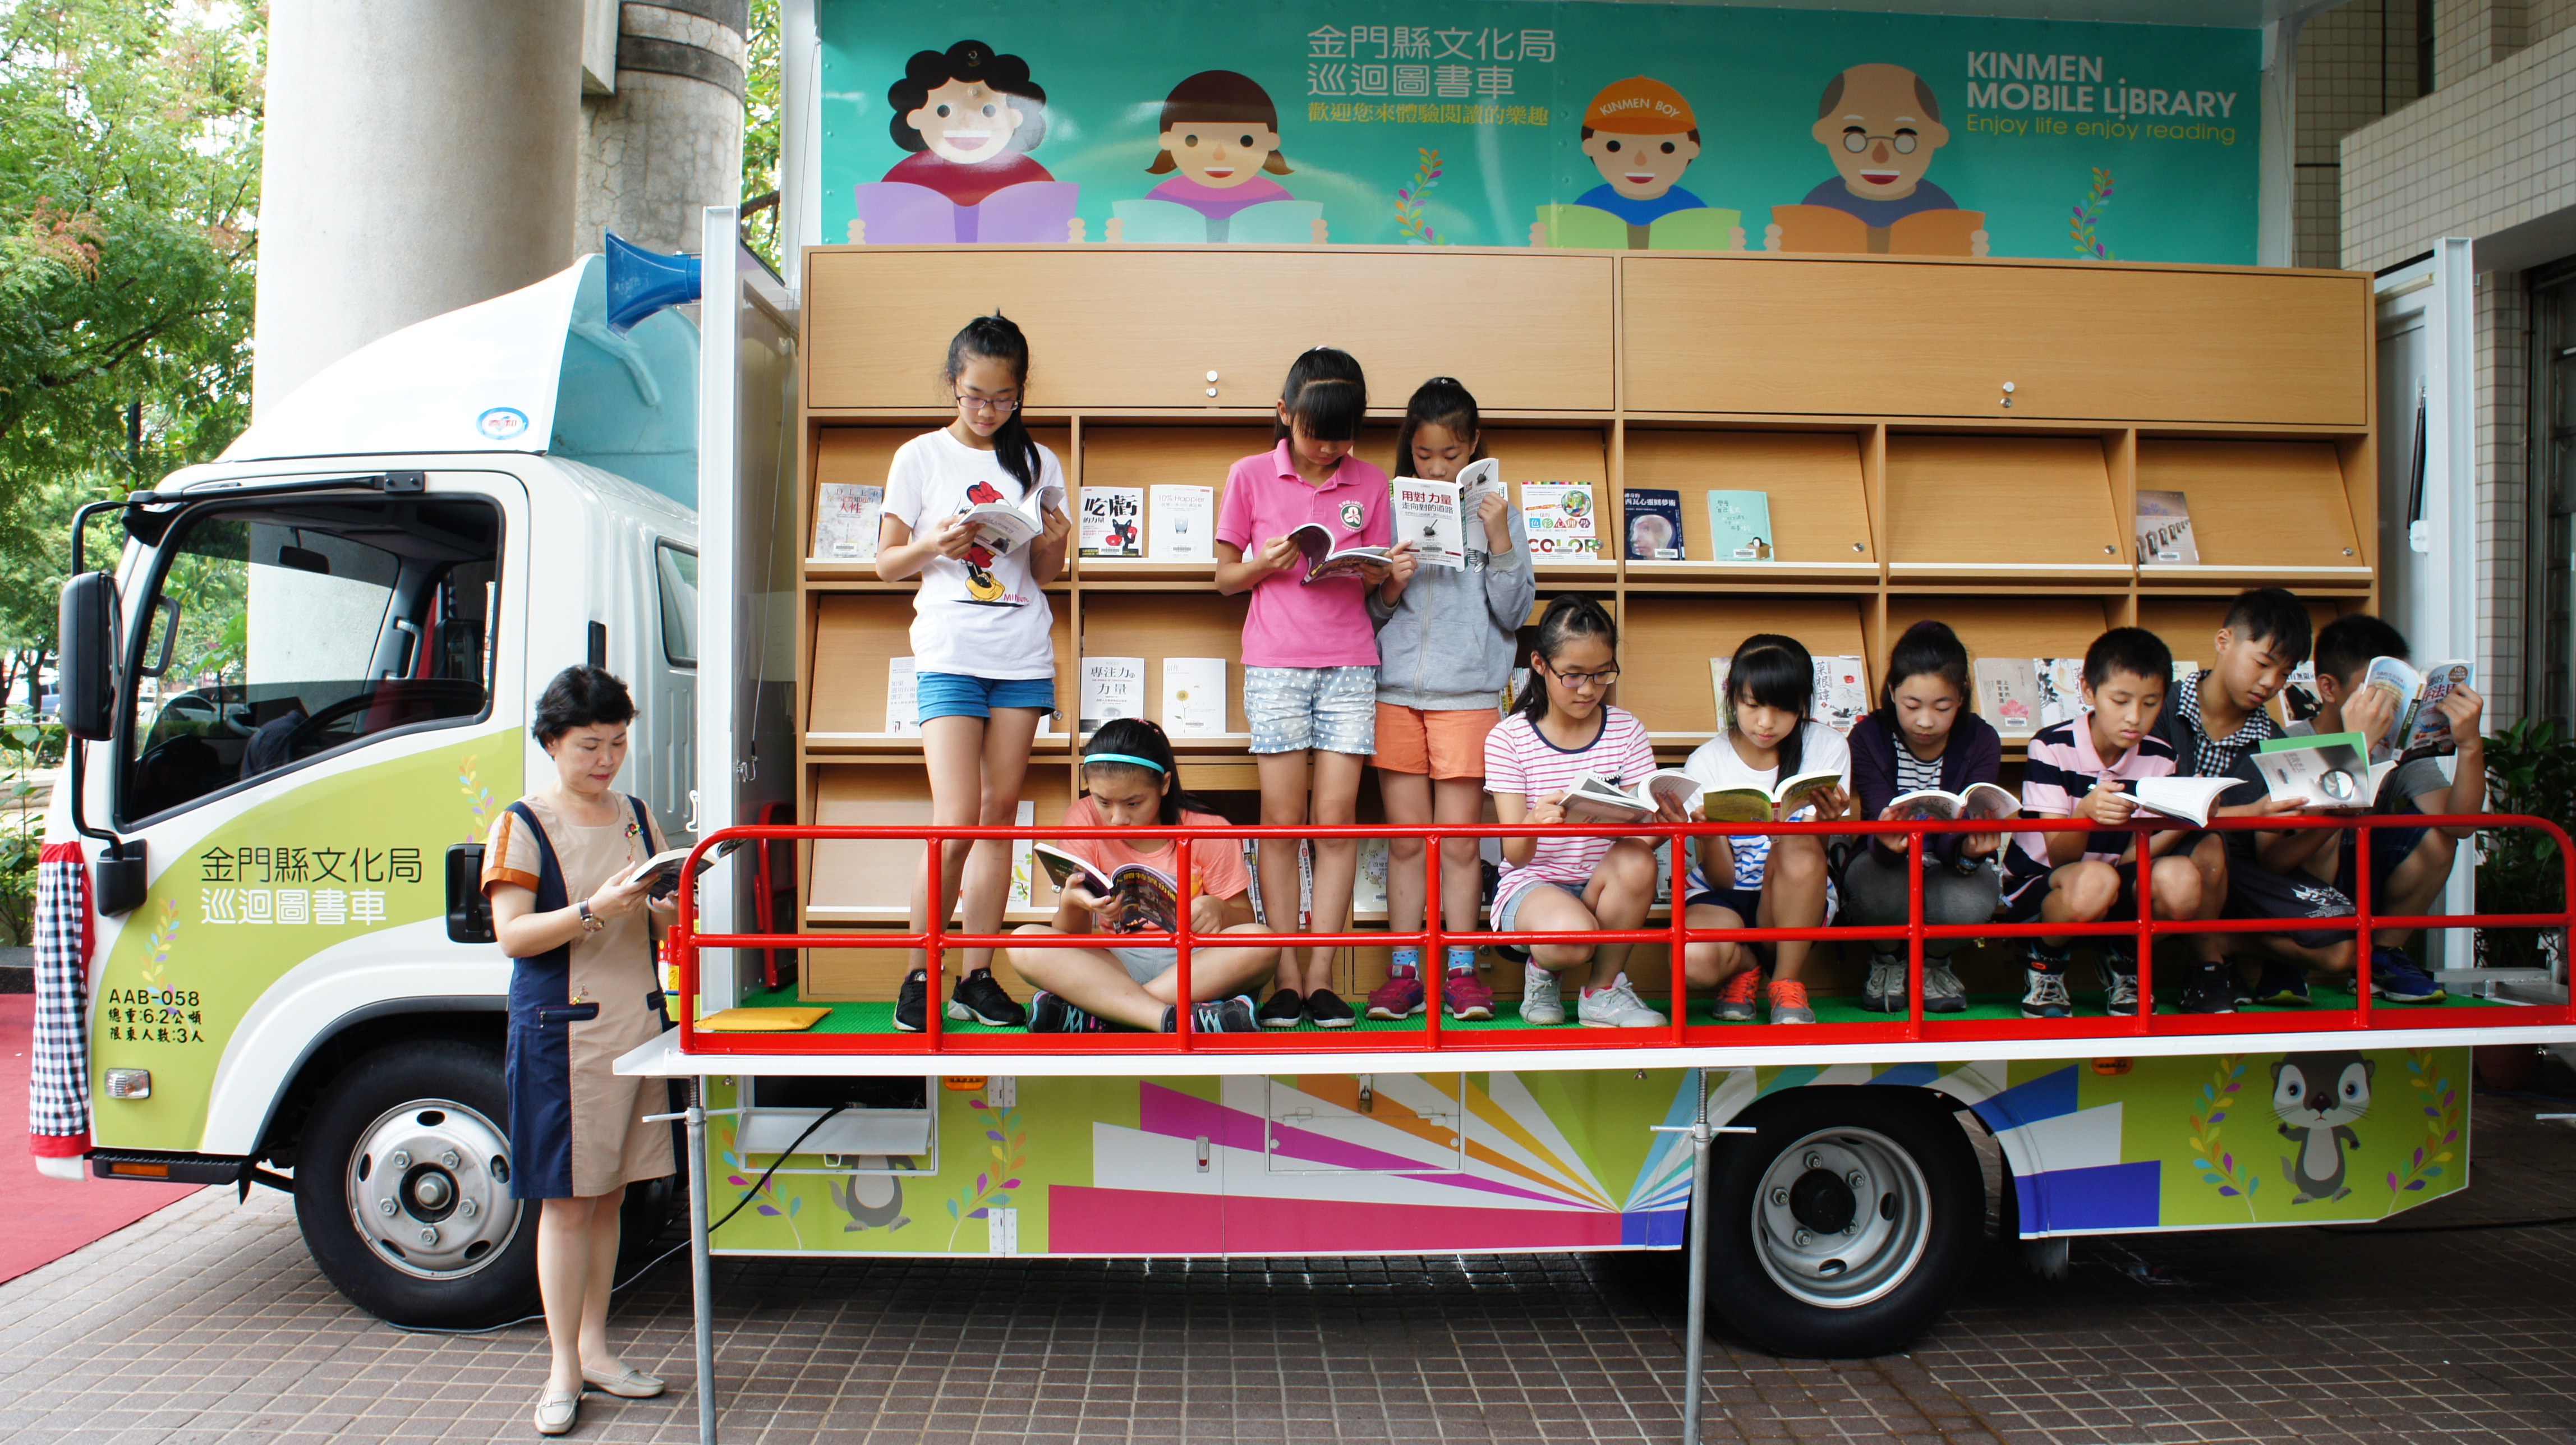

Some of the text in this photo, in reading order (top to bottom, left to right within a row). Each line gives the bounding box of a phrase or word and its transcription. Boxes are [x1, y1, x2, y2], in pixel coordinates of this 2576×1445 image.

[1307, 24, 1556, 62] 金門縣文化局
[1307, 62, 1515, 99] 巡迴圖書車
[1967, 51, 2103, 82] KINMEN
[1599, 98, 1681, 118] KINMEN BOY
[1967, 81, 2094, 112] MOBILE
[1308, 102, 1549, 126] 歡迎您來體驗閱讀的樂趣
[1967, 114, 2236, 146] Enjoy life enjoy reading
[1084, 494, 1138, 517] 吃虧
[1401, 501, 1453, 515] 走向對的道路
[201, 846, 422, 883] 金門縣文化局
[201, 887, 387, 926] 巡迴圖書車
[109, 988, 200, 1007] AAB-058
